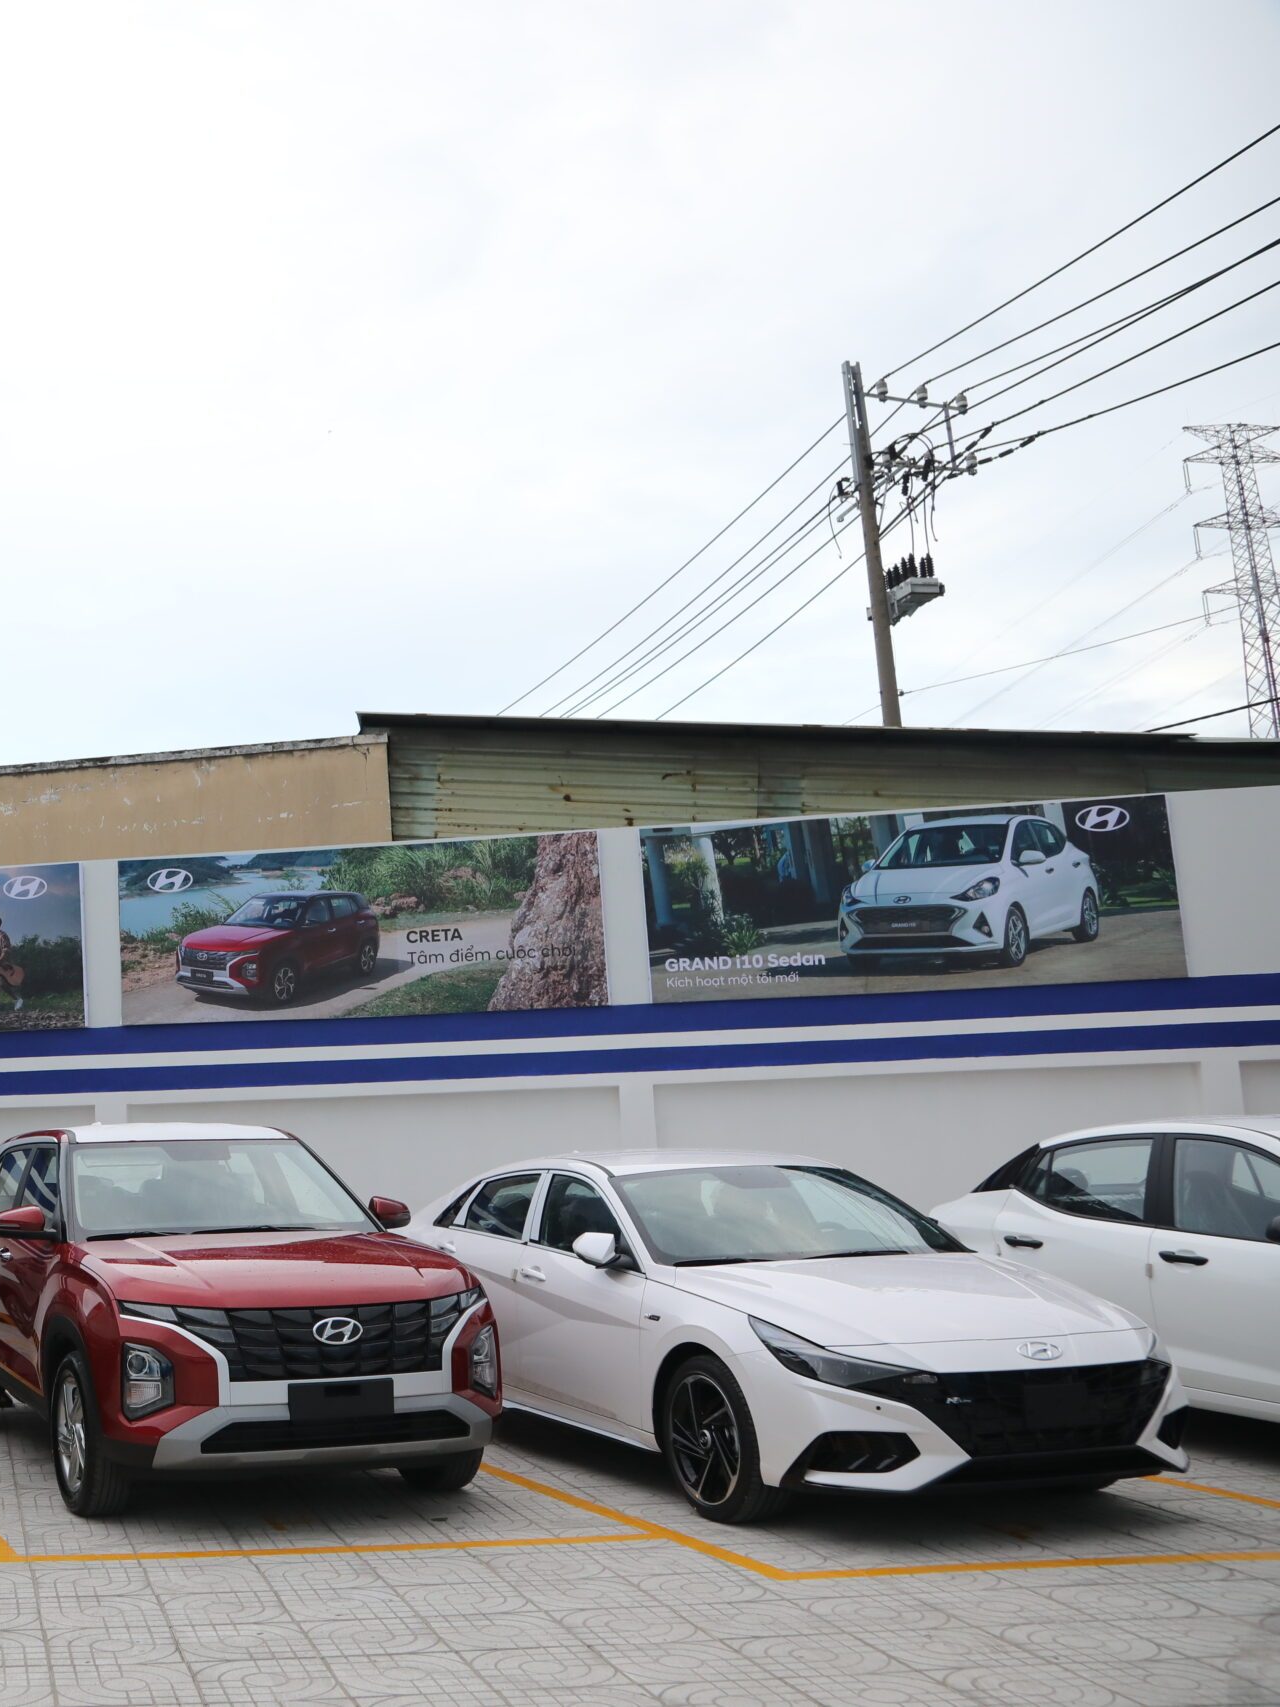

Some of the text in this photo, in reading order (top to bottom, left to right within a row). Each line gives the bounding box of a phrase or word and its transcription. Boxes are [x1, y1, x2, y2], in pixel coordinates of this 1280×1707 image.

[406, 928, 463, 943] CRETA
[407, 951, 445, 965] Tâm
[449, 945, 491, 962] điểm
[495, 945, 536, 962] cuộc
[665, 952, 826, 972] GRAND i10 Sedan
[666, 976, 693, 988] Kích
[696, 974, 725, 989] hoạt
[728, 974, 753, 986] một
[775, 971, 799, 983] mới
